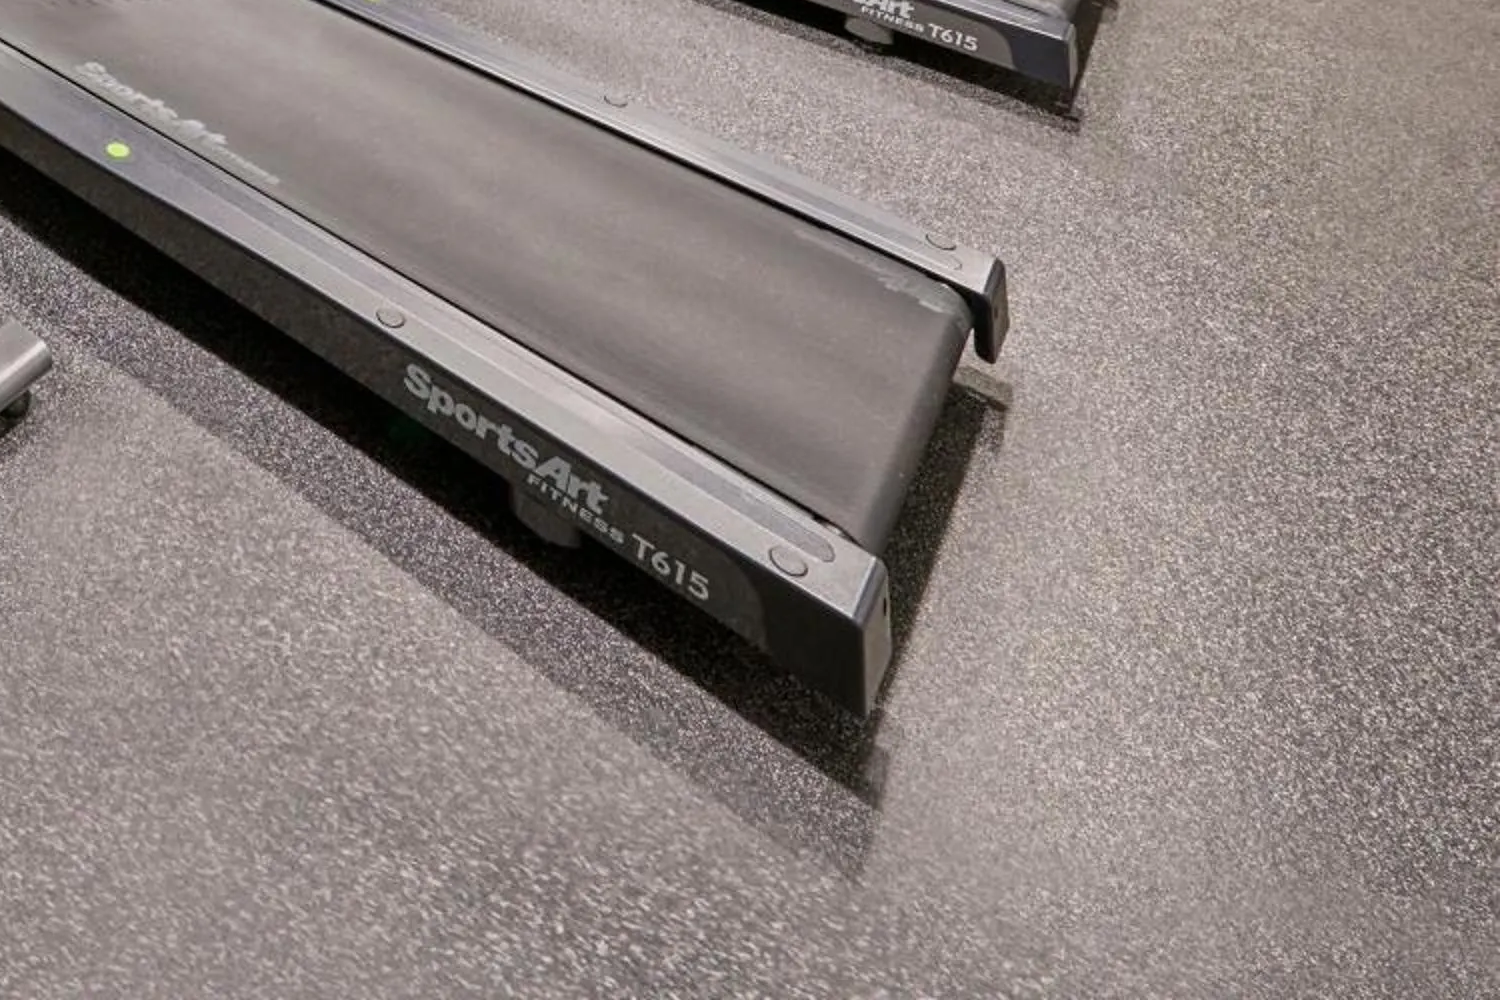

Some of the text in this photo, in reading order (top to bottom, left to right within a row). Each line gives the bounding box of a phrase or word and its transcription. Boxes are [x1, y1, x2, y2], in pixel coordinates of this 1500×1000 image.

[861, 6, 979, 51] FITNESS T615
[403, 363, 609, 516] SportsArt
[527, 473, 710, 601] FITNESS T615
